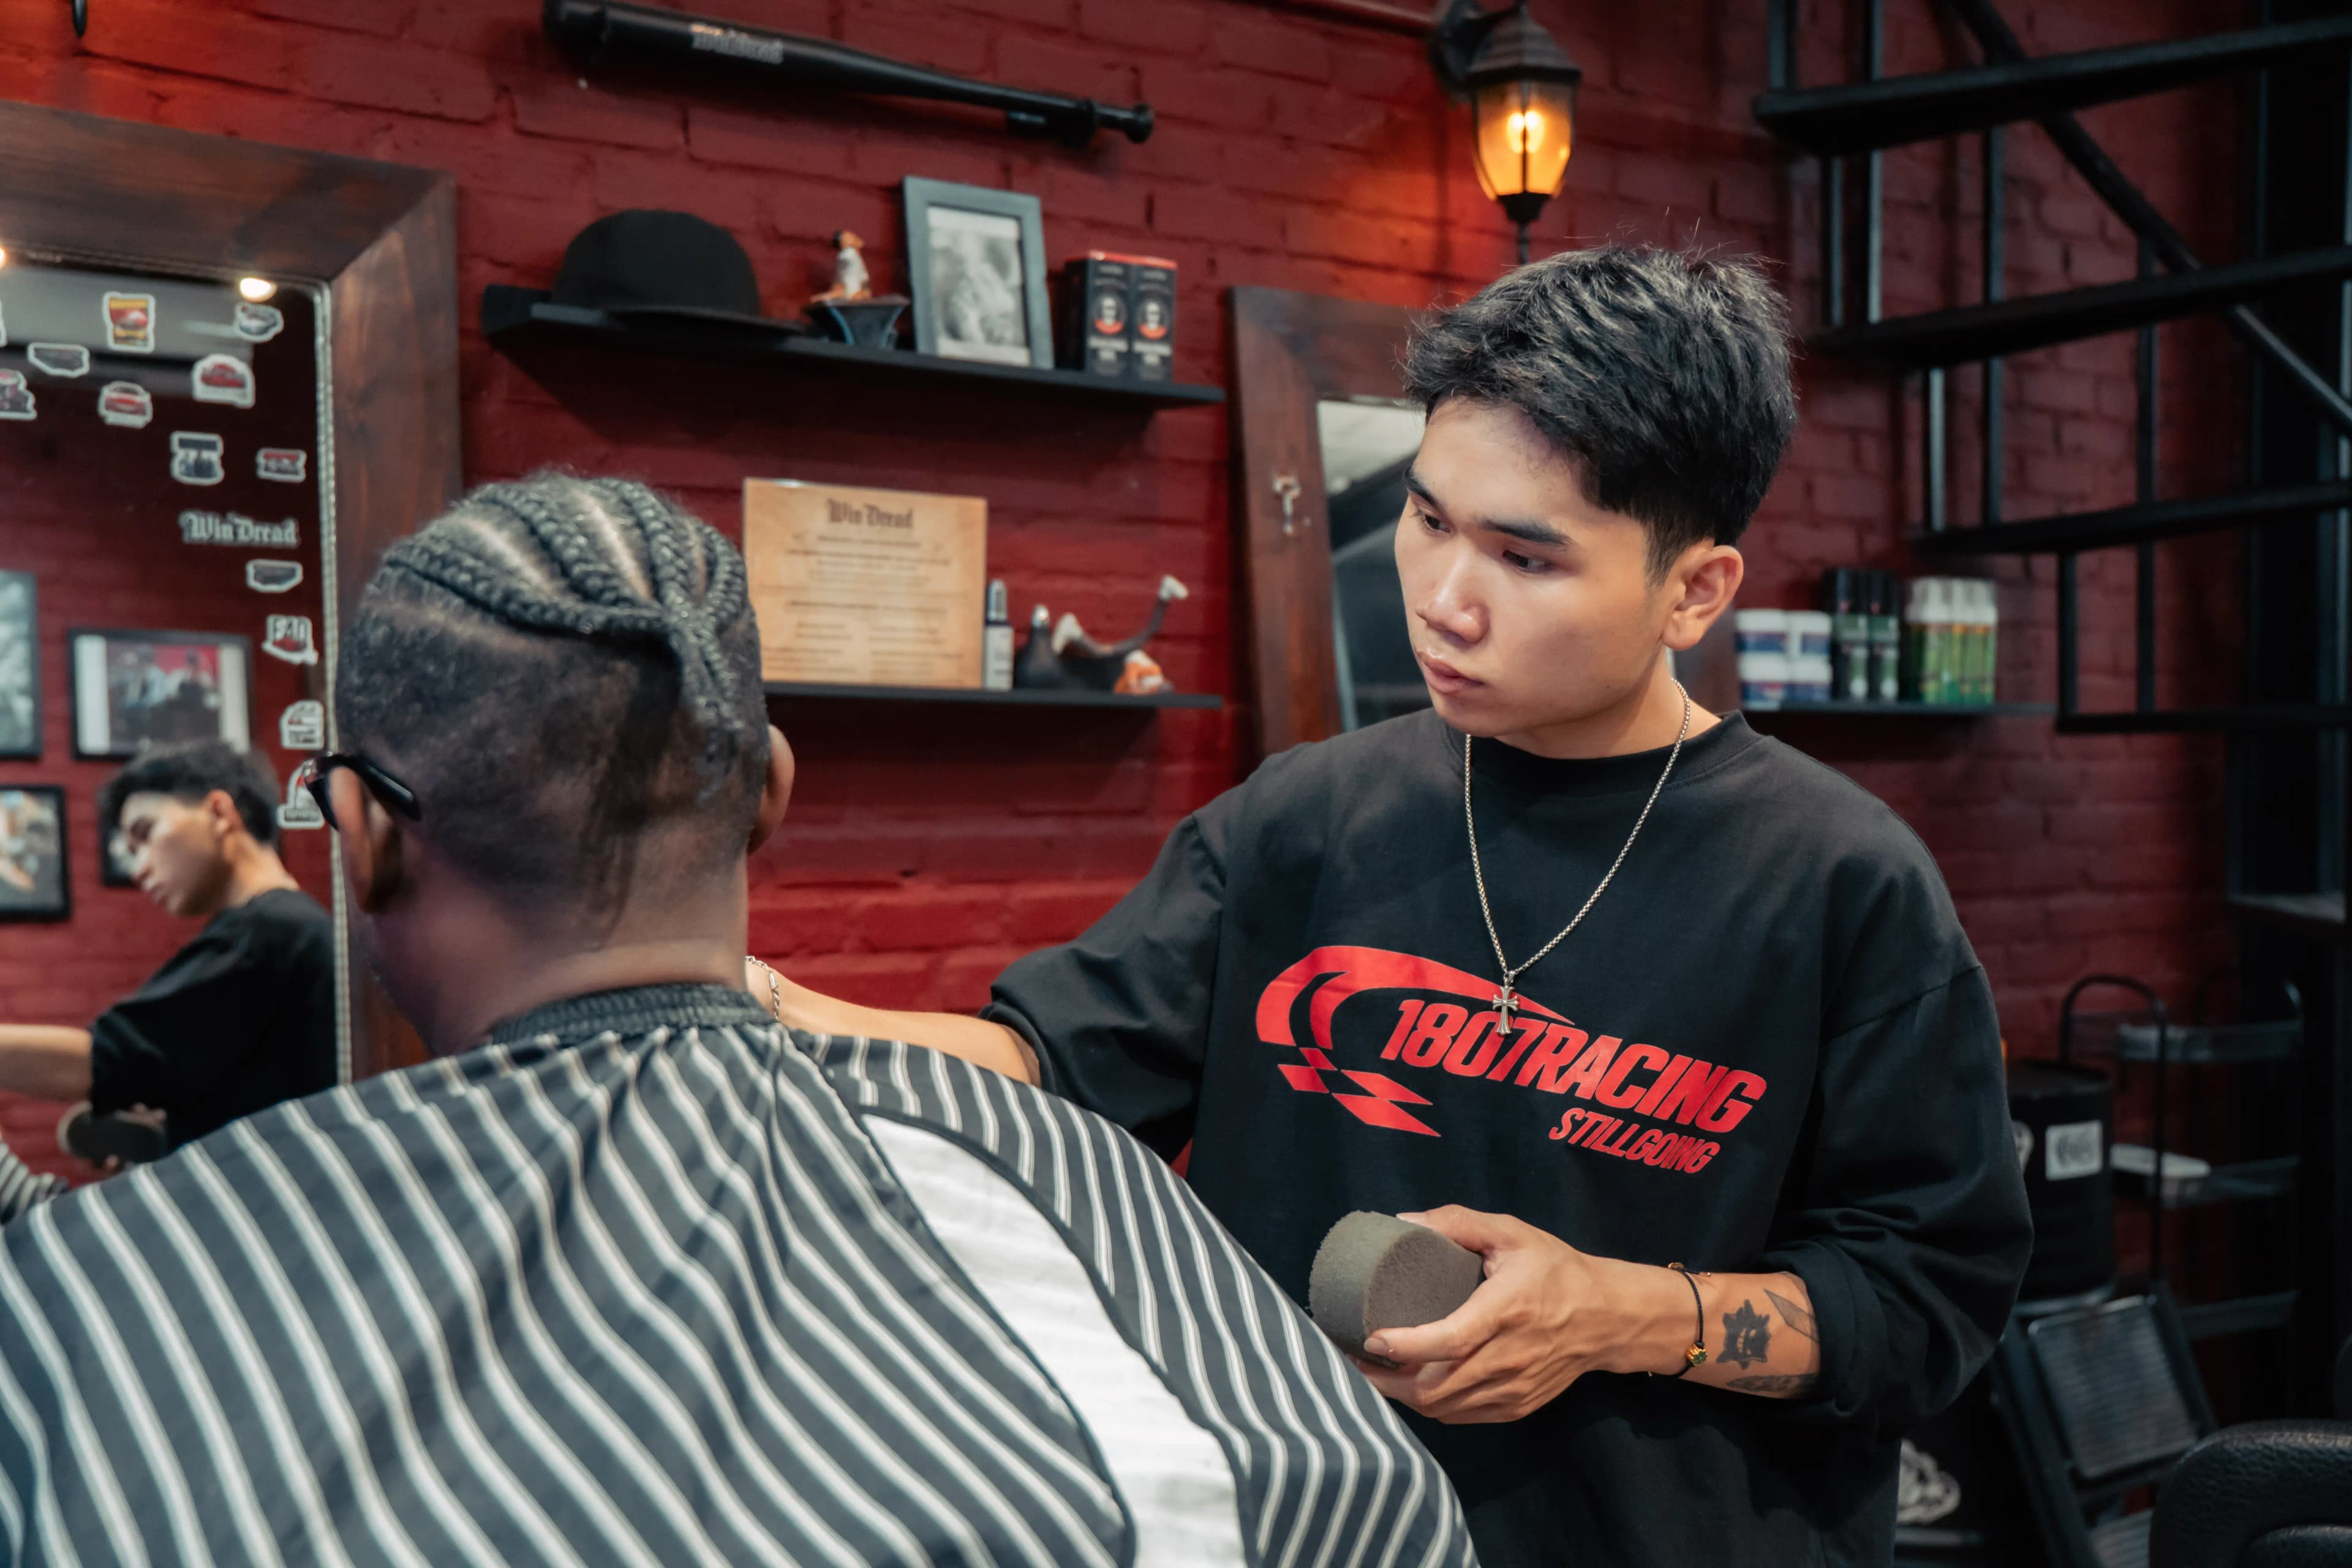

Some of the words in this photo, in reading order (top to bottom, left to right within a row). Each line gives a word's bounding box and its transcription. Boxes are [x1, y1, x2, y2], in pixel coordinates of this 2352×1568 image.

[181, 511, 234, 542] Win
[228, 514, 298, 546] Dread
[1381, 1000, 1768, 1133] 1807RACING
[1548, 1107, 1721, 1174] STILLGOING
